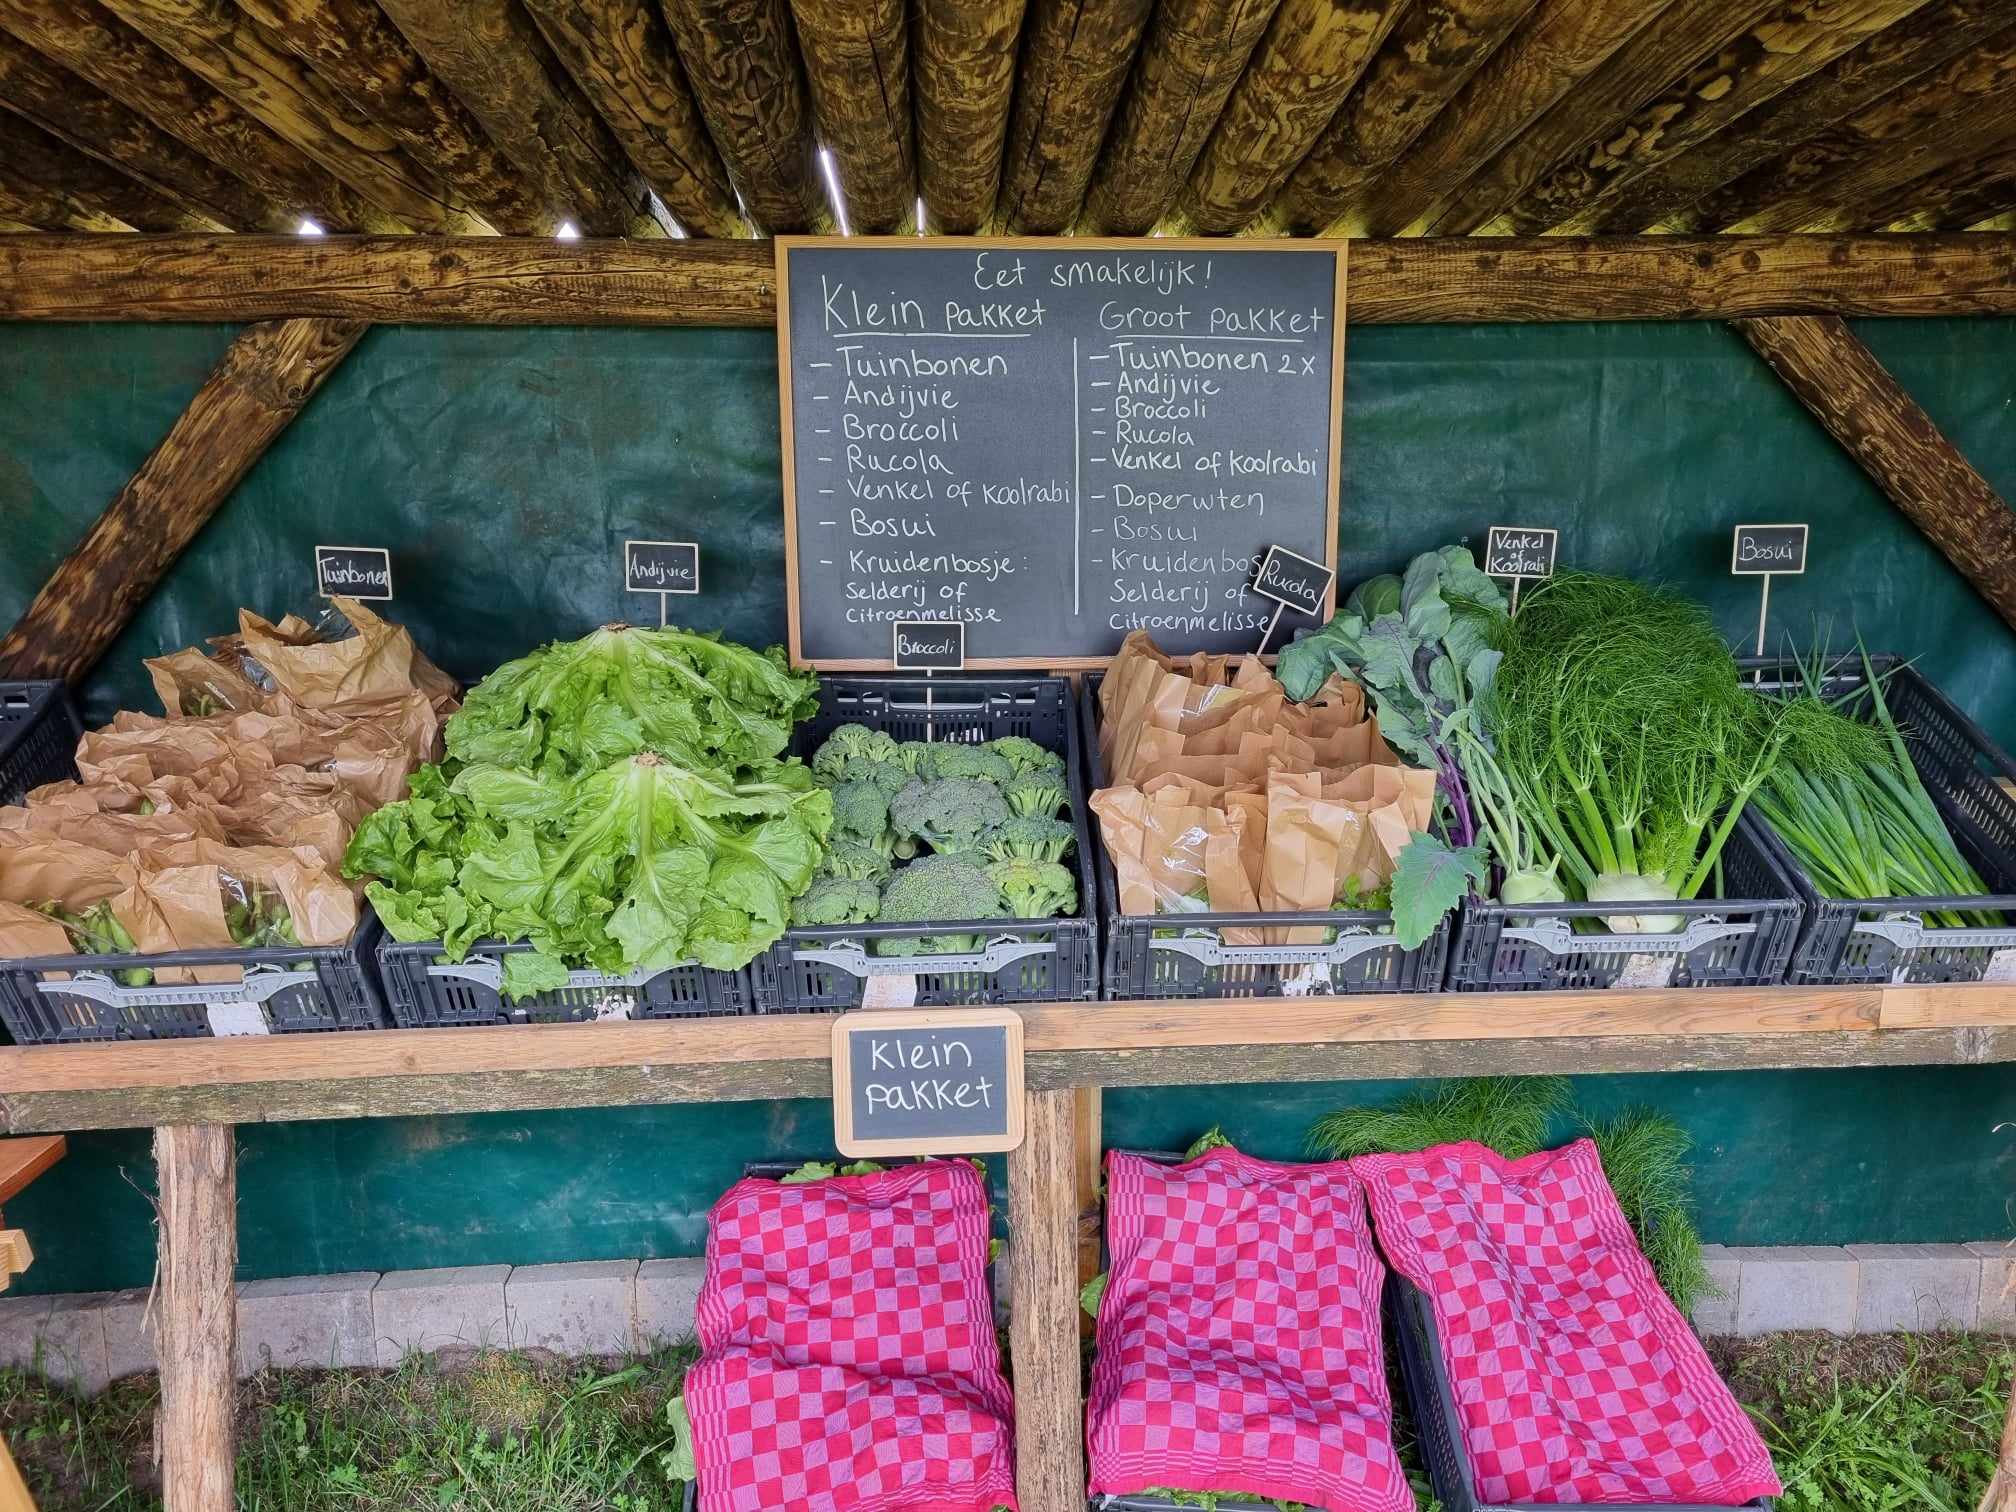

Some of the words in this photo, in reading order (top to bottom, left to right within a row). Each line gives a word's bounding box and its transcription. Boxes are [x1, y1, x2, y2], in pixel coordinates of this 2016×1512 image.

[974, 252, 1026, 289] Eet
[822, 275, 924, 331] Klein
[1100, 301, 1191, 329] Groot
[836, 345, 1008, 377] Tuinbonen
[1110, 342, 1268, 372] Tuinbonen
[844, 380, 959, 418] Andijvie
[1117, 371, 1220, 403] Andijvie
[1115, 395, 1206, 419] Broccoli
[843, 414, 959, 441] Broccoli
[1116, 420, 1194, 445] Rucola
[847, 444, 953, 474] Rucola
[1112, 444, 1181, 470] Venkel
[1195, 452, 1221, 477] of
[1230, 448, 1319, 476] koolrabi
[847, 475, 933, 500] Venkel
[946, 481, 972, 507] of
[1113, 484, 1264, 515] Doperwten
[851, 508, 936, 536] Bosui
[1114, 515, 1197, 541] Bosui
[1496, 531, 1544, 549] Venkel
[1740, 536, 1792, 561] Bosui
[629, 552, 696, 585] Andijvie
[1263, 559, 1319, 605] Rucola
[846, 580, 926, 606] Selderij
[939, 582, 968, 602] of
[1110, 578, 1209, 612] Selderij
[1225, 583, 1251, 606] of
[898, 634, 956, 656] Broccoli
[872, 1035, 972, 1070] Klein
